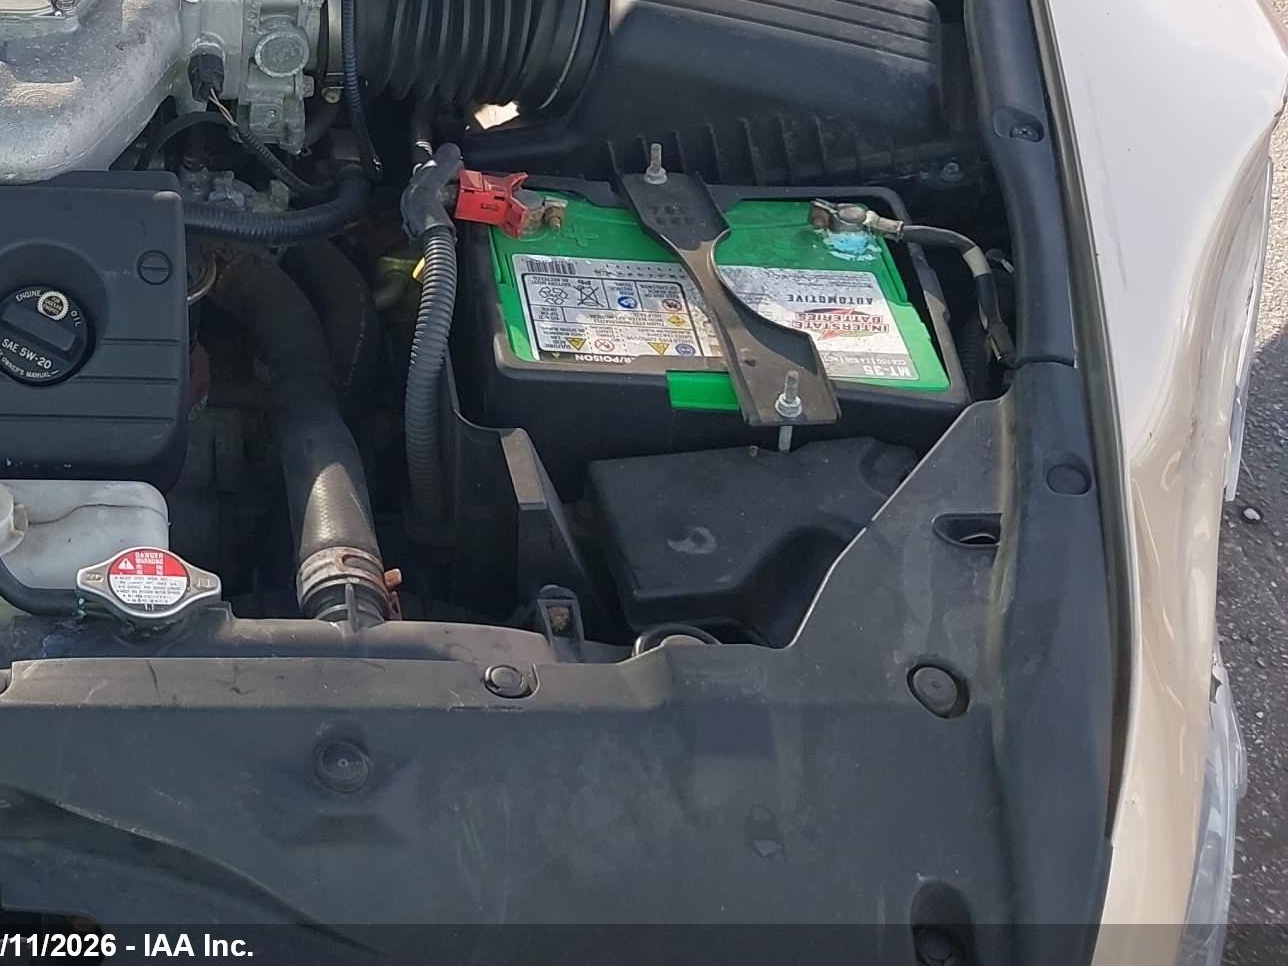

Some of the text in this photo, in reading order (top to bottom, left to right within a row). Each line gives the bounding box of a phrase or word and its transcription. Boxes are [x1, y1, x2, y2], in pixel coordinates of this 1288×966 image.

[786, 293, 873, 305] AUTOMOTIVE
[15, 289, 82, 328] ENGINE OIL
[797, 313, 883, 323] BATTERIES
[792, 320, 890, 333] INTERSTATE
[1, 338, 52, 369] SAE 5W-20
[25, 370, 52, 379] MANUAL
[862, 364, 911, 376] MT-35
[134, 551, 165, 560] DANGER
